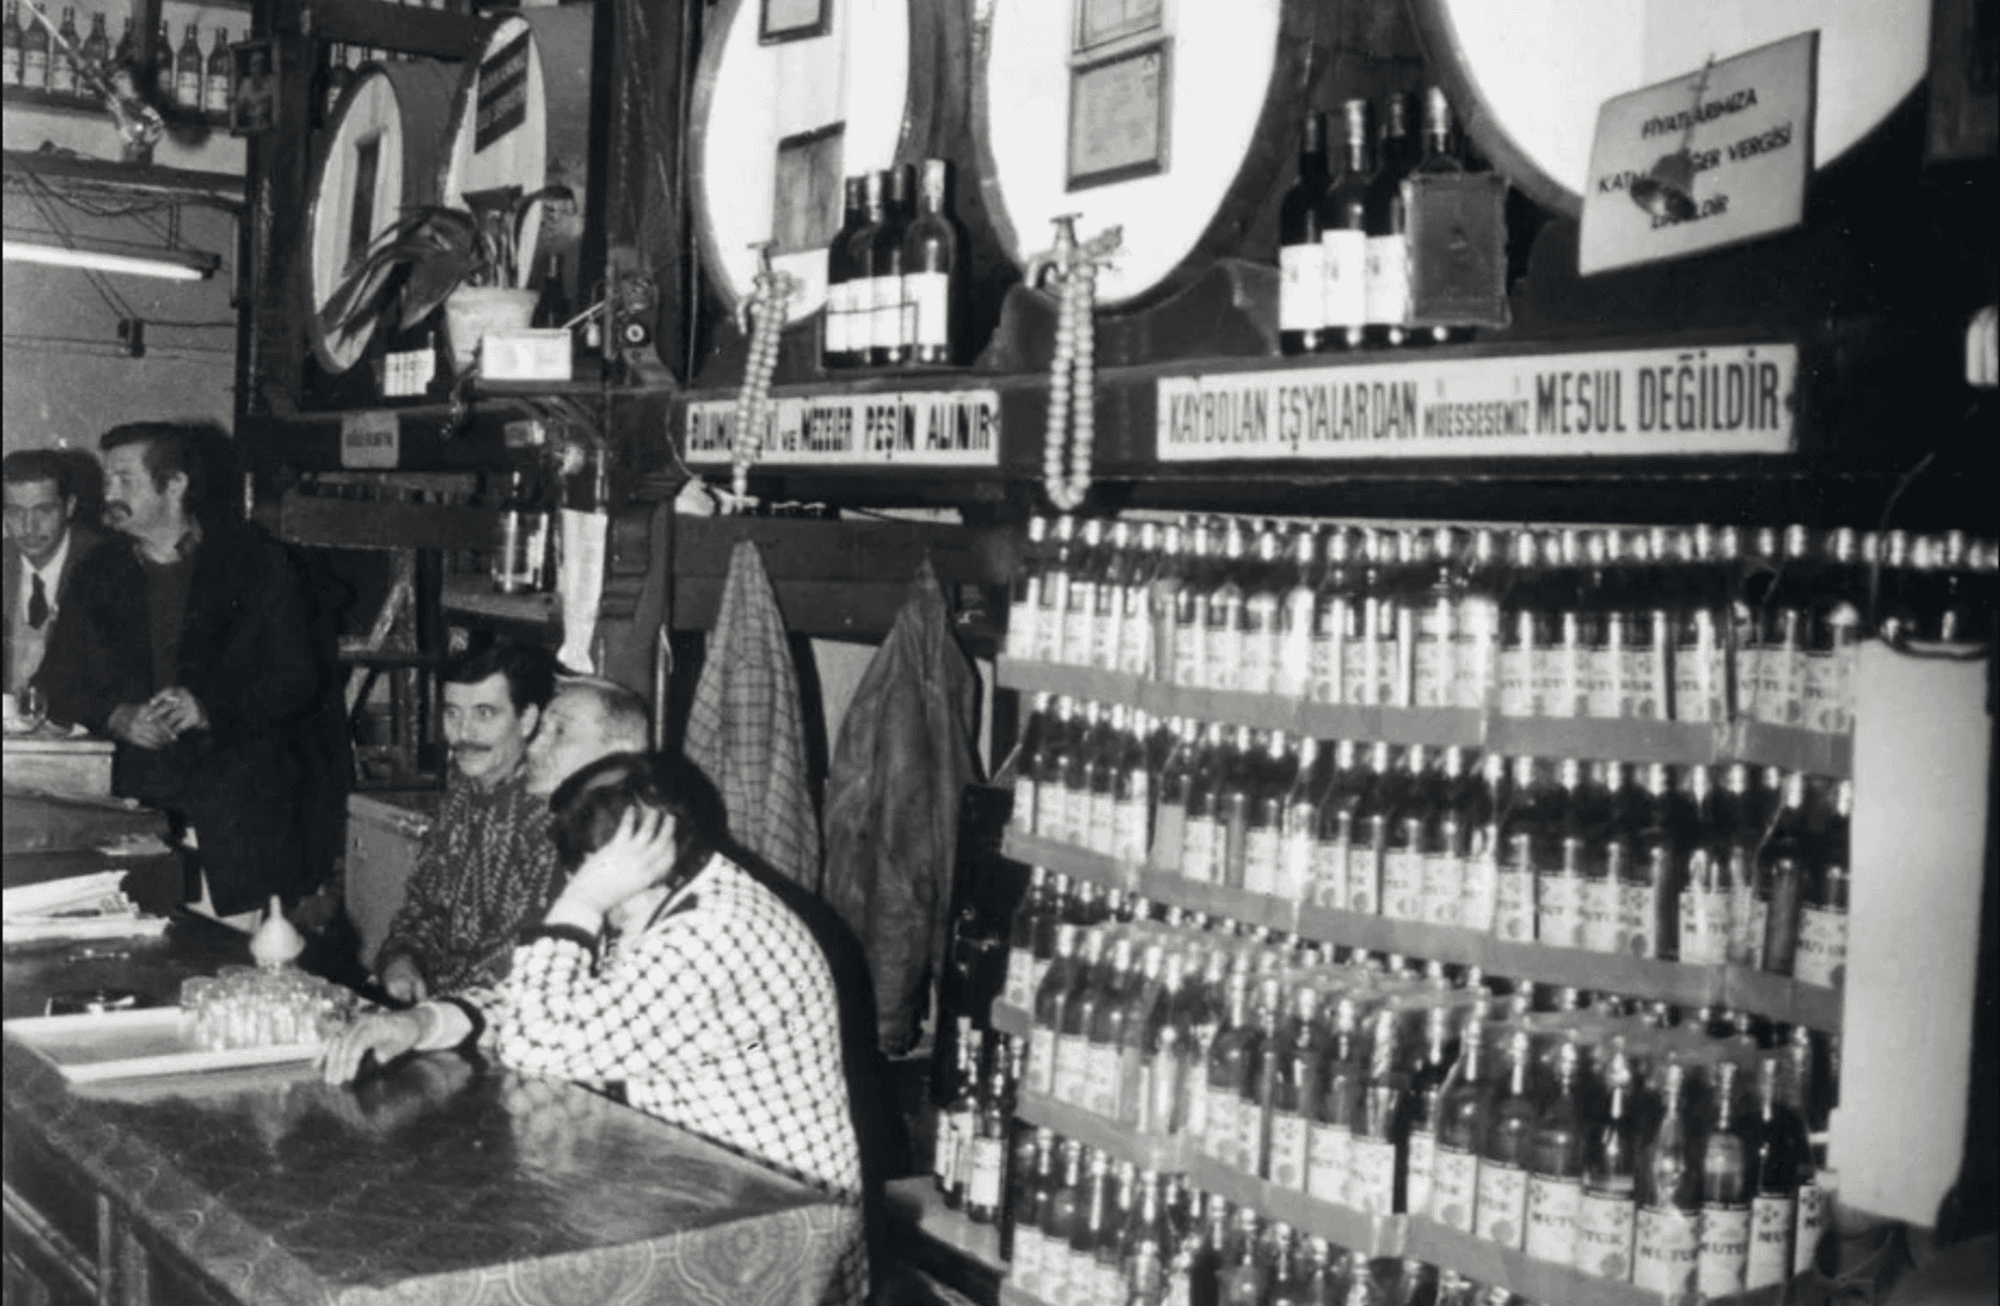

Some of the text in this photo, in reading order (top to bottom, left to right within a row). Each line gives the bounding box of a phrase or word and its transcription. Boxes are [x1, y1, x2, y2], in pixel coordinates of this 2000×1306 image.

[1726, 120, 1794, 161] VERGİSİ
[866, 396, 916, 460] PEŞİN
[926, 402, 990, 451] ALINIR
[1169, 389, 1269, 444] KAYBOLAN
[1278, 381, 1418, 454] EŞYALARDAN
[1535, 369, 1627, 434] MESUL
[1638, 347, 1780, 432] DEĞİLDİR
